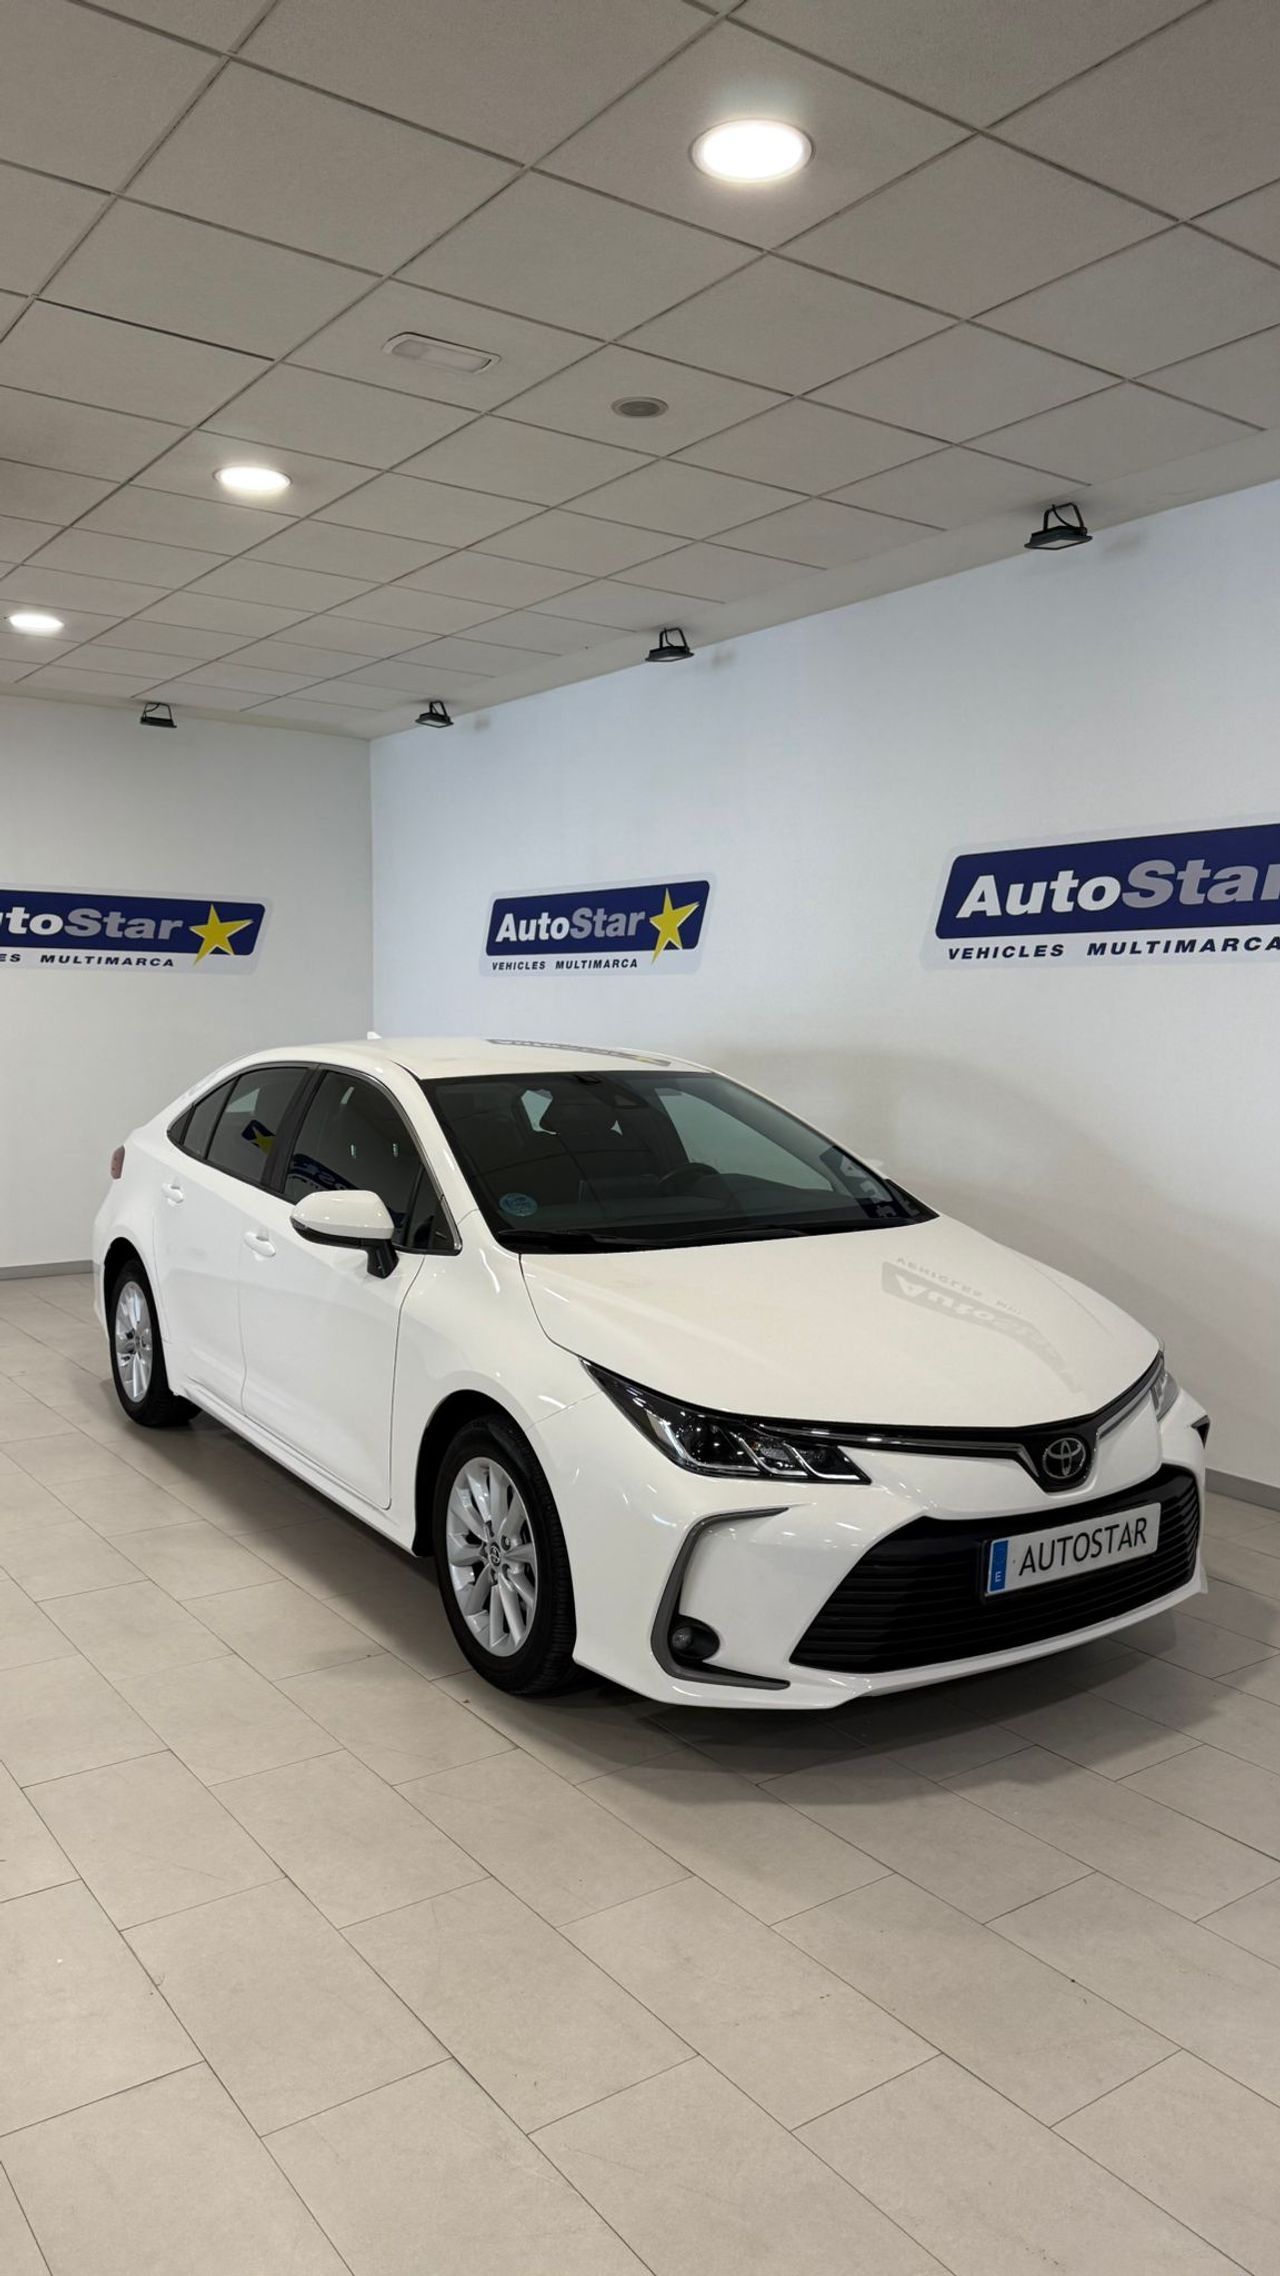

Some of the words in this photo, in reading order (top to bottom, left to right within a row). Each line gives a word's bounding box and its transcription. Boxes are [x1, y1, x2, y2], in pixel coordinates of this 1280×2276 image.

[0, 906, 183, 940] toStar
[495, 907, 646, 942] AutoStar
[948, 943, 1065, 960] VEHICLES
[1086, 936, 1280, 956] MULTIMARCA
[40, 954, 174, 967] MULTIMARCA
[492, 960, 546, 971] VEHICLES
[555, 958, 638, 970] MULTIMARCA
[1018, 1517, 1147, 1577] AUTOSTAR
[994, 1571, 1002, 1582] E
